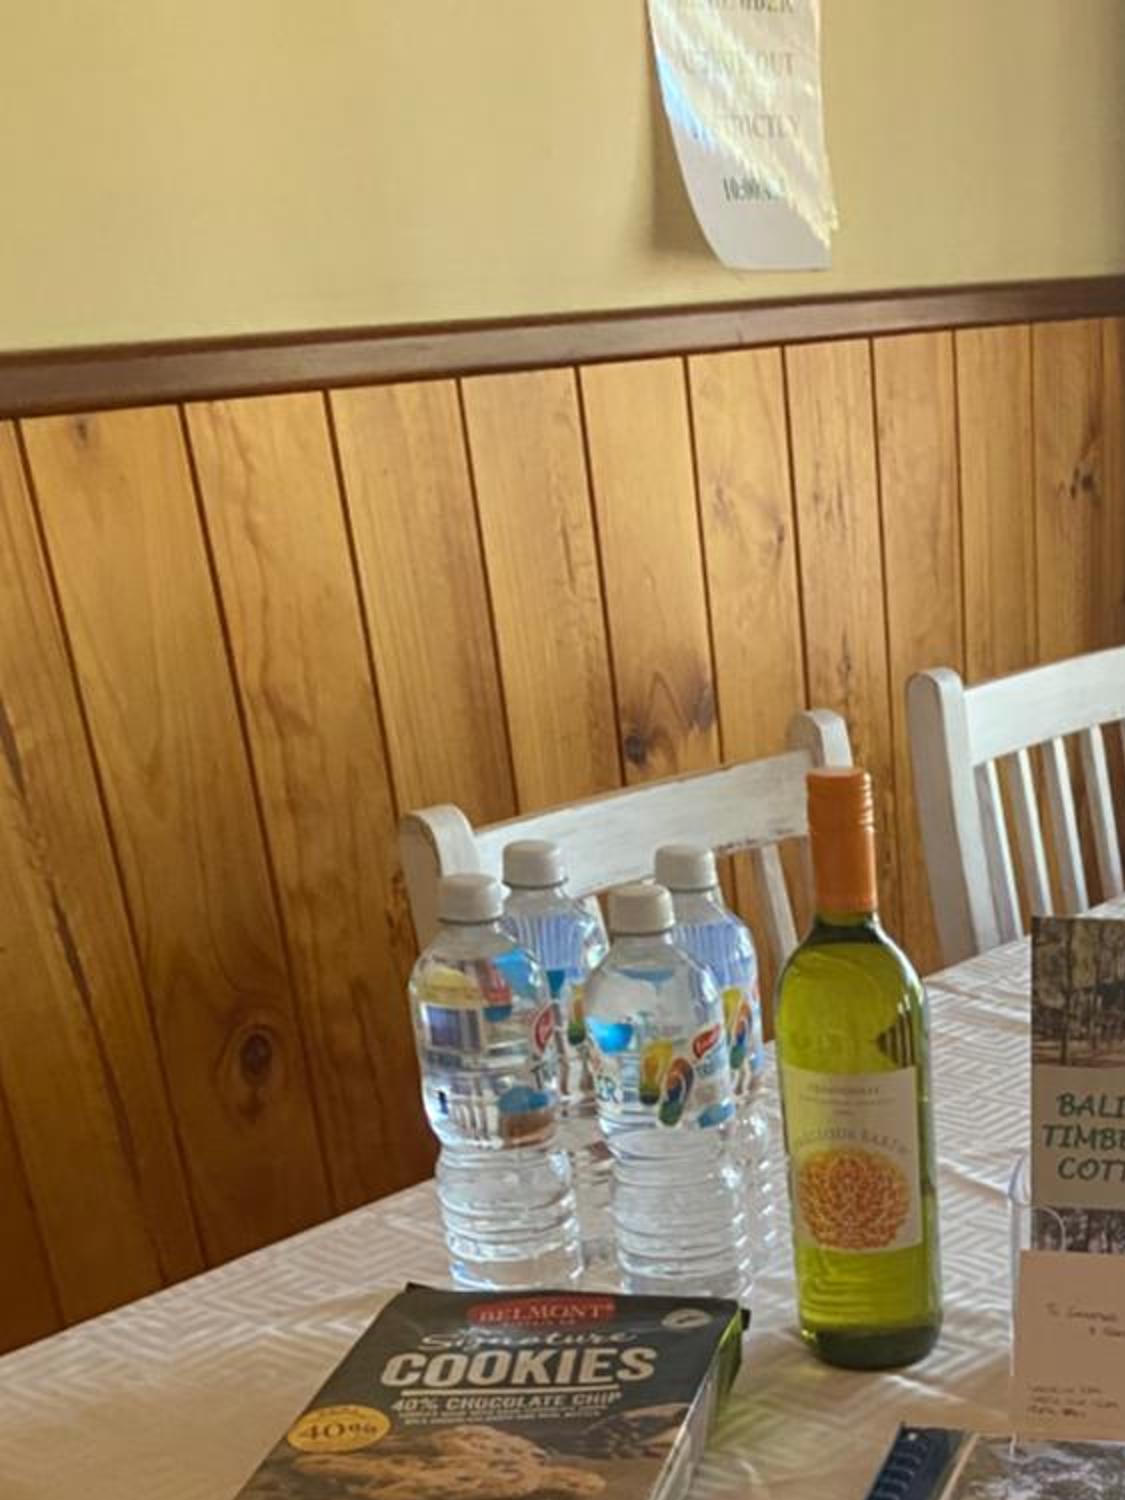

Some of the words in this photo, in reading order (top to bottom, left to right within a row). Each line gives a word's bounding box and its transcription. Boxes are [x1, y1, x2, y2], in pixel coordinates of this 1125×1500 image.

[479, 1302, 603, 1322] BELMONT
[380, 1347, 658, 1387] COOKIES
[391, 1398, 438, 1412] 40%
[446, 1395, 568, 1410] CHOCOLATE
[572, 1392, 622, 1406] CHIP
[298, 1422, 379, 1441] 40%
